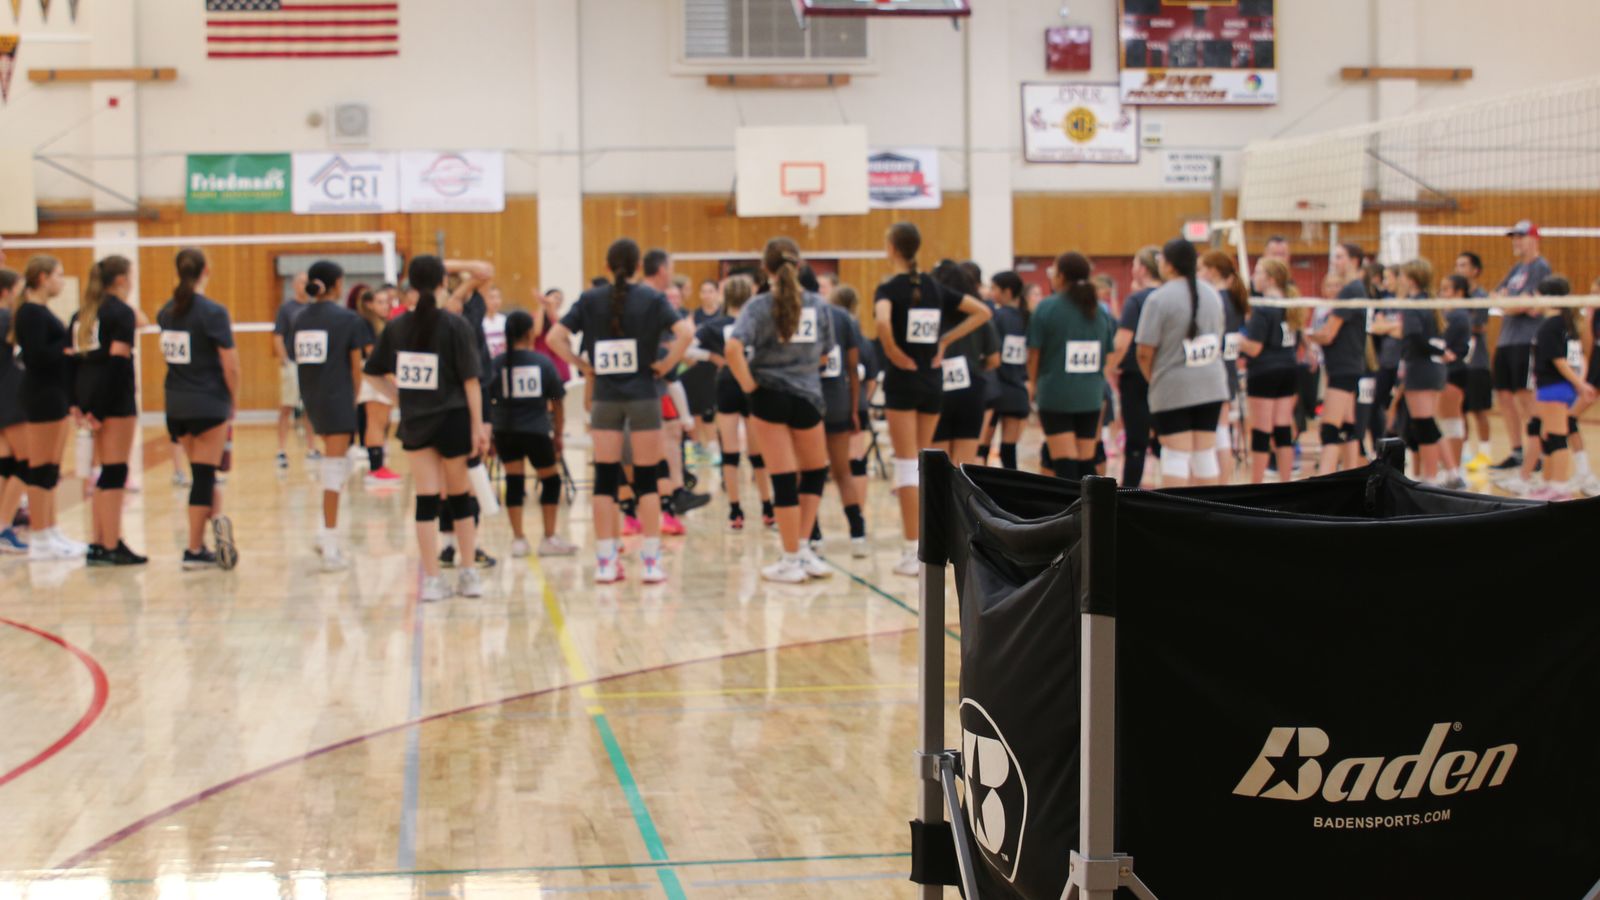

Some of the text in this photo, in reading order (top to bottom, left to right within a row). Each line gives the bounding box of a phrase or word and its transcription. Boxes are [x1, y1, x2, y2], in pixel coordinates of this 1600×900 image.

[323, 174, 378, 200] CRI
[599, 351, 633, 369] 313
[400, 365, 433, 383] 337
[1231, 722, 1518, 803] Baden
[1313, 808, 1451, 829] BADENSPORTS.COM
